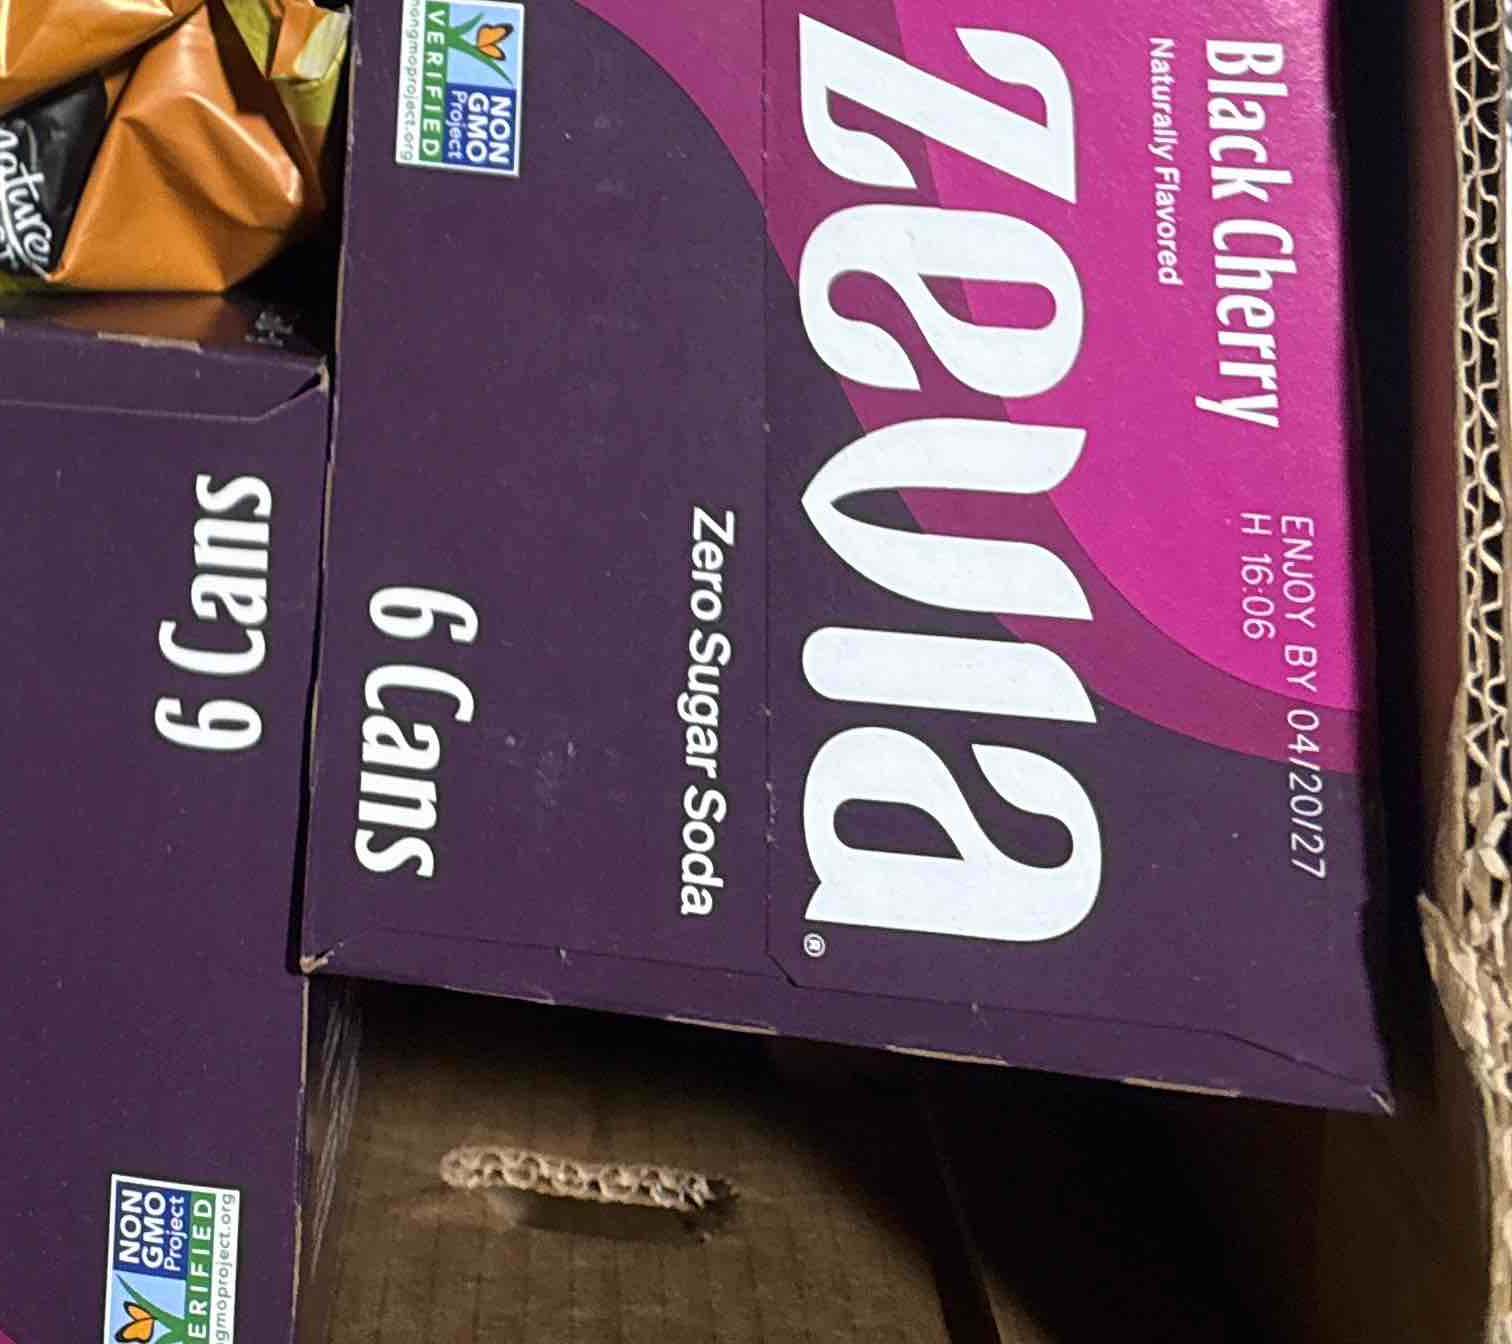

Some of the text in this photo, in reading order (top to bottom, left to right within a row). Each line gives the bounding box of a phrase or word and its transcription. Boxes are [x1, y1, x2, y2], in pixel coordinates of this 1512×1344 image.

[422, 10, 445, 155] VERIFIED
[446, 90, 468, 160] Project
[465, 92, 489, 163] GMO
[488, 95, 512, 164] NON
[1148, 36, 1185, 287] Naturally Flavored
[1197, 39, 1298, 431] Black Cherry
[153, 472, 273, 755] 6 Cans
[1241, 513, 1276, 640] H 16:06
[354, 585, 480, 879] 6 Cans
[677, 507, 736, 919] Zero Sugar Soda
[1279, 514, 1328, 879] ENJOY BY 04/20/27
[119, 1189, 143, 1264] NON
[141, 1191, 166, 1269] GMO
[164, 1195, 188, 1271] Project
[188, 1199, 212, 1338] ERIFIED
